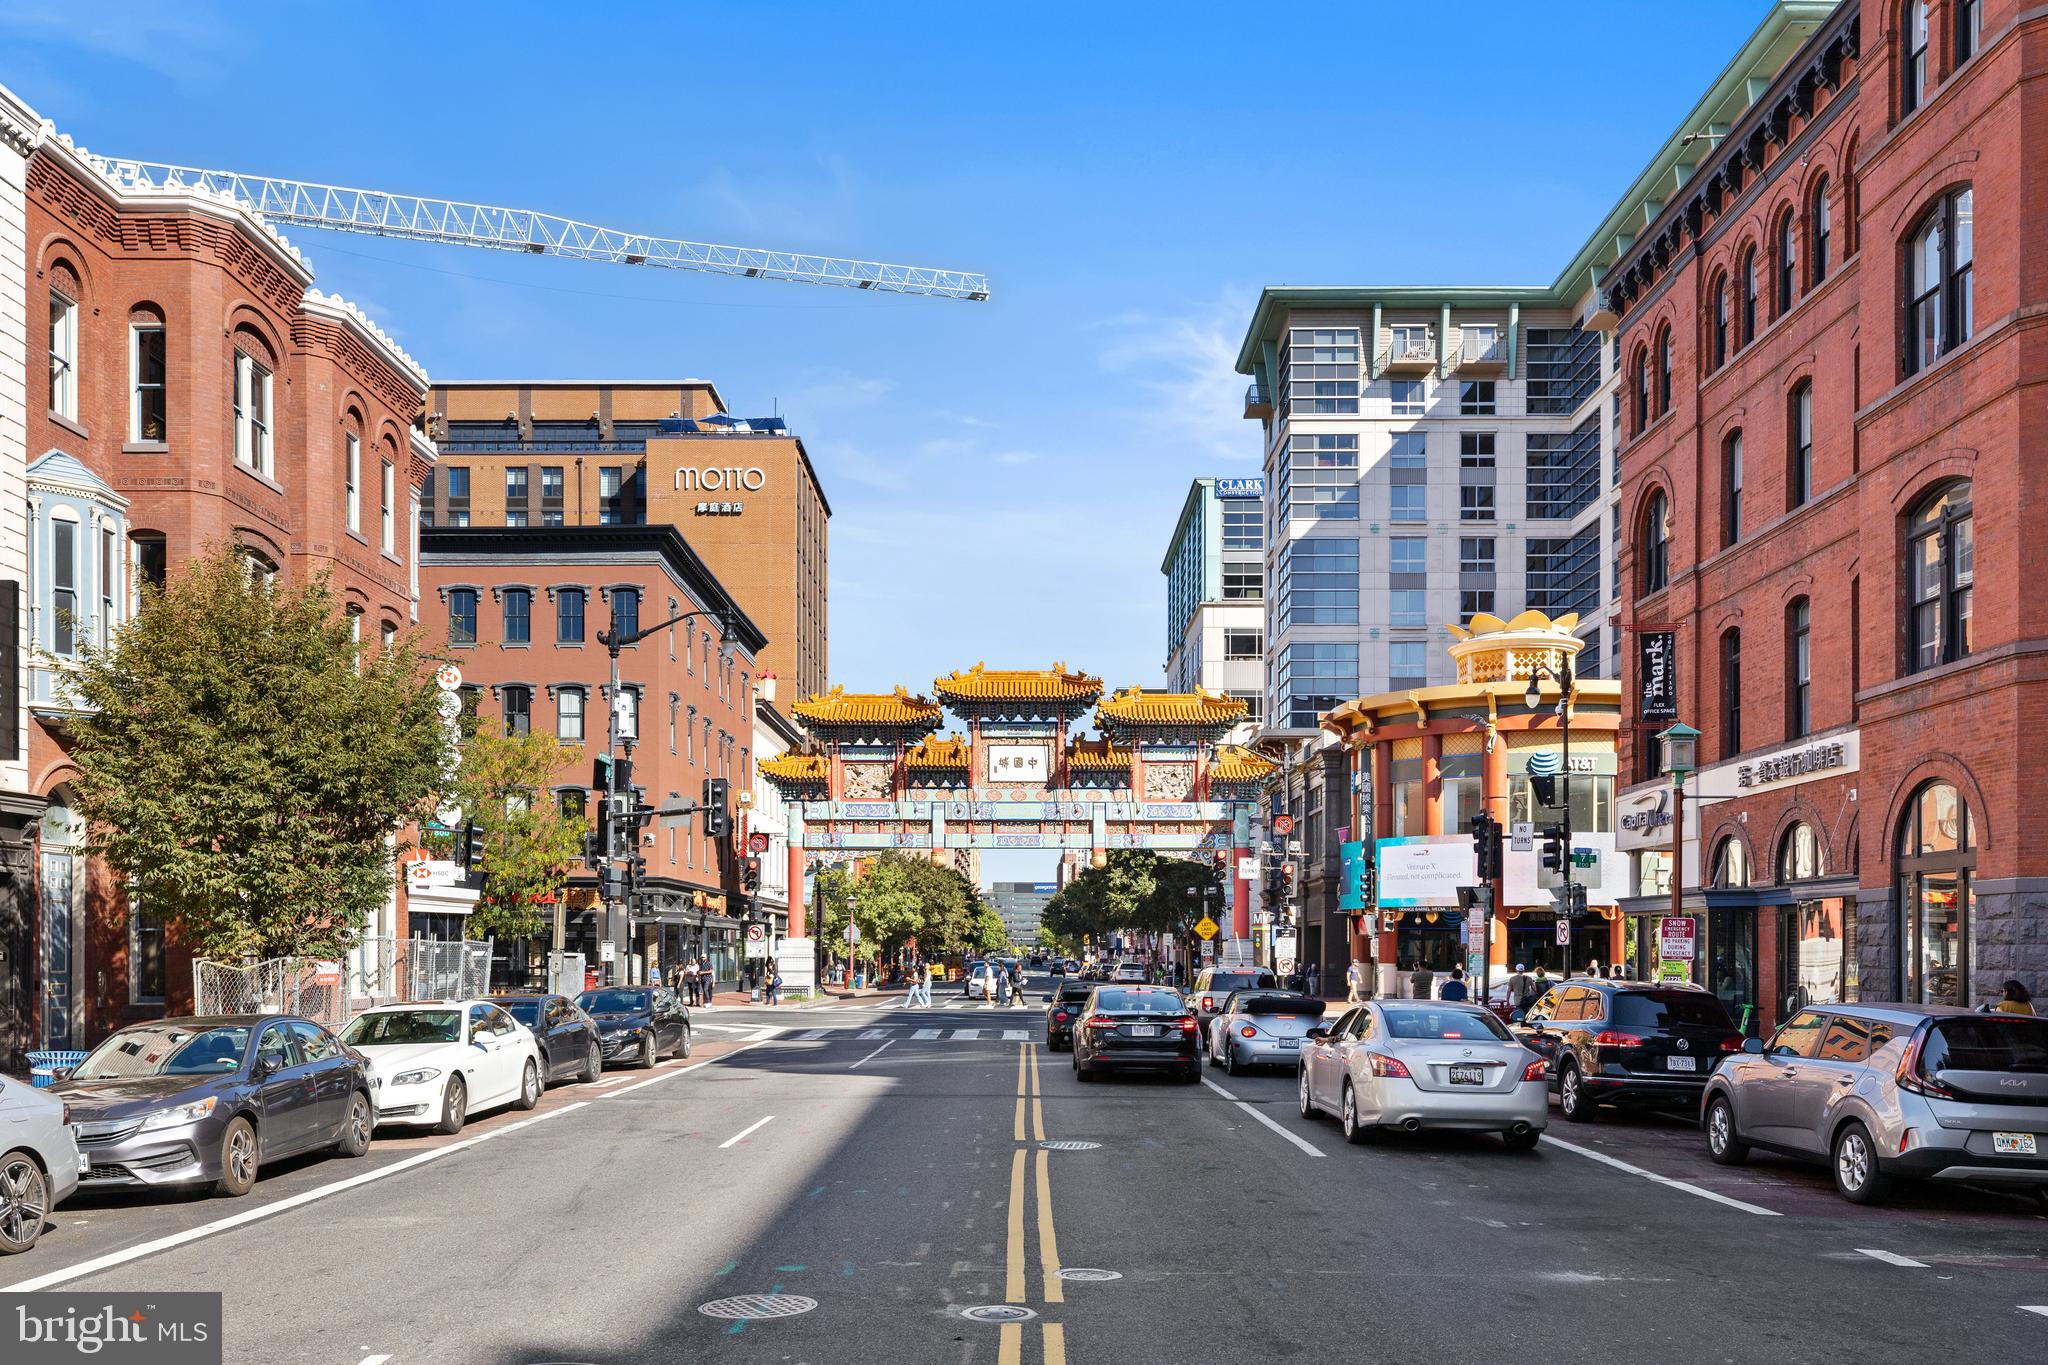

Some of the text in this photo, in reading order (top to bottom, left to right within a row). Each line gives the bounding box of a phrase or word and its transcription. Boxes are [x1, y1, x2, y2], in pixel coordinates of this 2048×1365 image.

[1219, 479, 1263, 490] CLARK
[697, 502, 744, 513] 摩庭酒店
[1643, 682, 1653, 698] the
[1621, 811, 1648, 831] Capital
[1514, 836, 1531, 844] TURNS
[1421, 871, 1463, 880] complicated.
[1253, 913, 1262, 924] M
